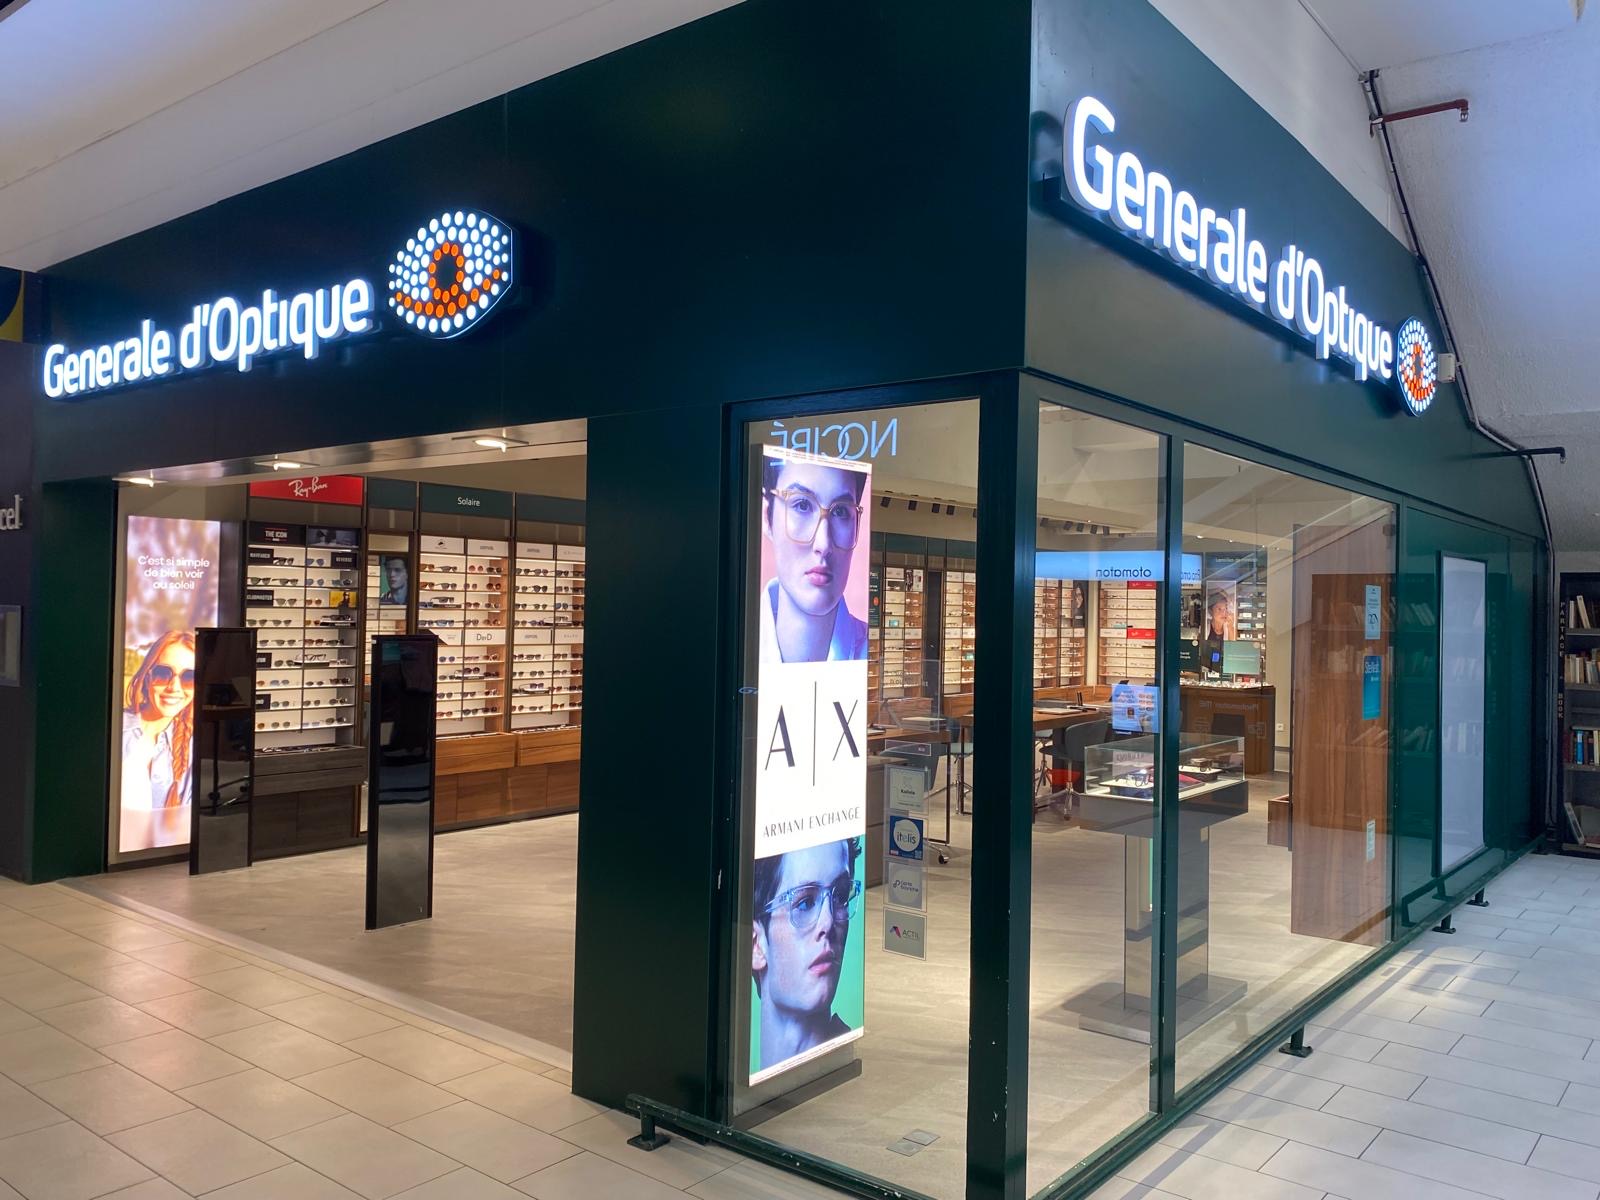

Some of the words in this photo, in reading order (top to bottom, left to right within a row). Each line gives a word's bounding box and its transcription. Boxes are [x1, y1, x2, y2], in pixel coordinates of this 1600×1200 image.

[1064, 95, 1267, 303] Generale
[1273, 244, 1393, 382] d'Optique
[43, 318, 172, 398] Generale
[179, 278, 371, 372] d'Optique
[288, 476, 328, 498] Ray-Ban
[457, 496, 481, 507] Solaire
[137, 555, 165, 566] C'est
[166, 556, 175, 566] si
[176, 557, 210, 568] simple
[144, 567, 159, 577] de
[160, 568, 183, 577] bien
[184, 569, 204, 579] voir
[153, 581, 167, 589] au
[168, 581, 195, 590] soleil
[763, 818, 804, 838] ARMANI
[809, 806, 861, 830] EXCHANGE
